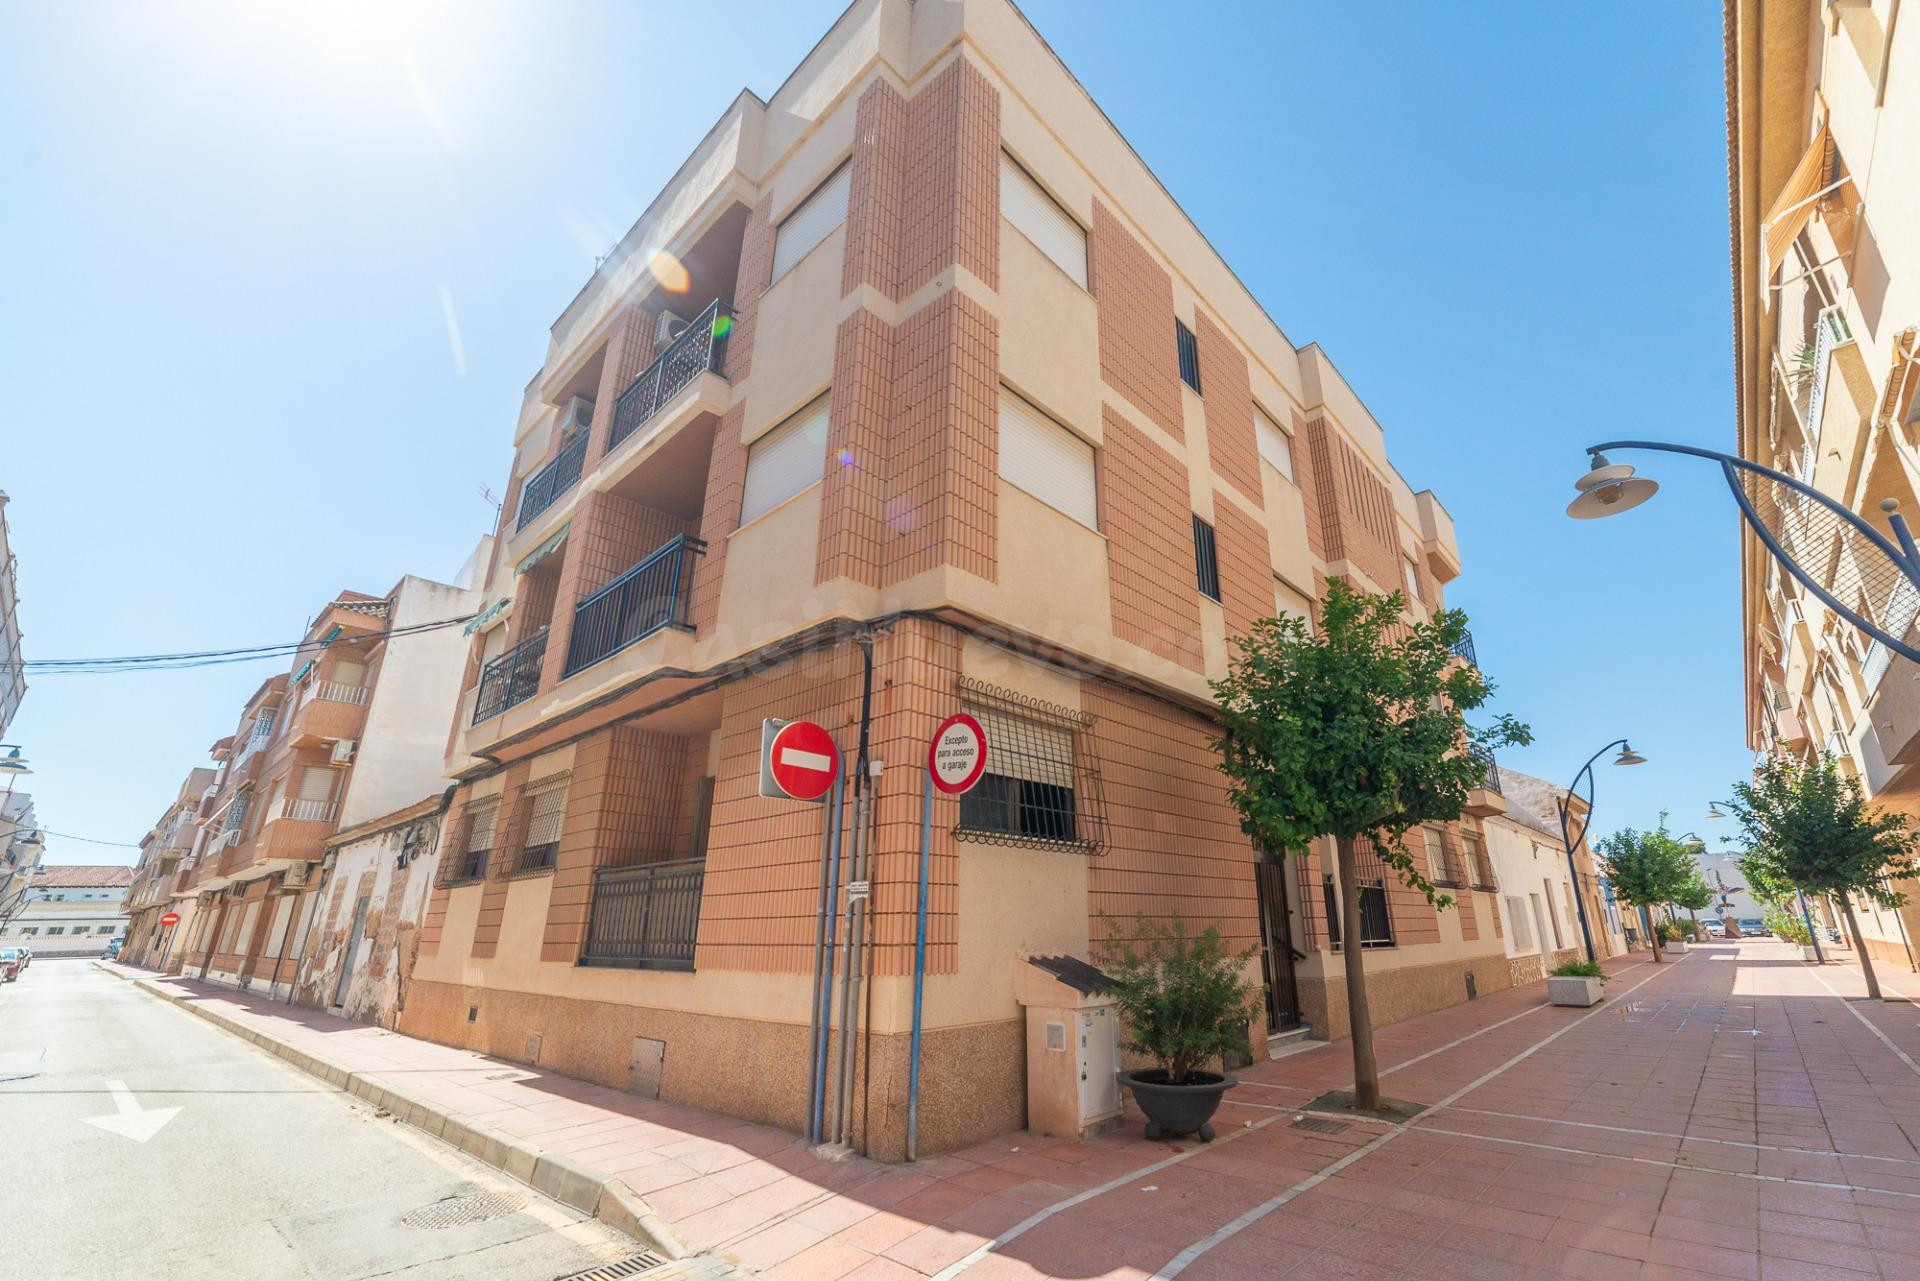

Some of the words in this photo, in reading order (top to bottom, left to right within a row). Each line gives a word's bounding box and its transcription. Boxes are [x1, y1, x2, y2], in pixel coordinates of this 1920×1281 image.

[945, 735, 968, 746] Excepto
[938, 749, 951, 759] para
[952, 748, 974, 757] acceso
[947, 759, 968, 771] garaje
